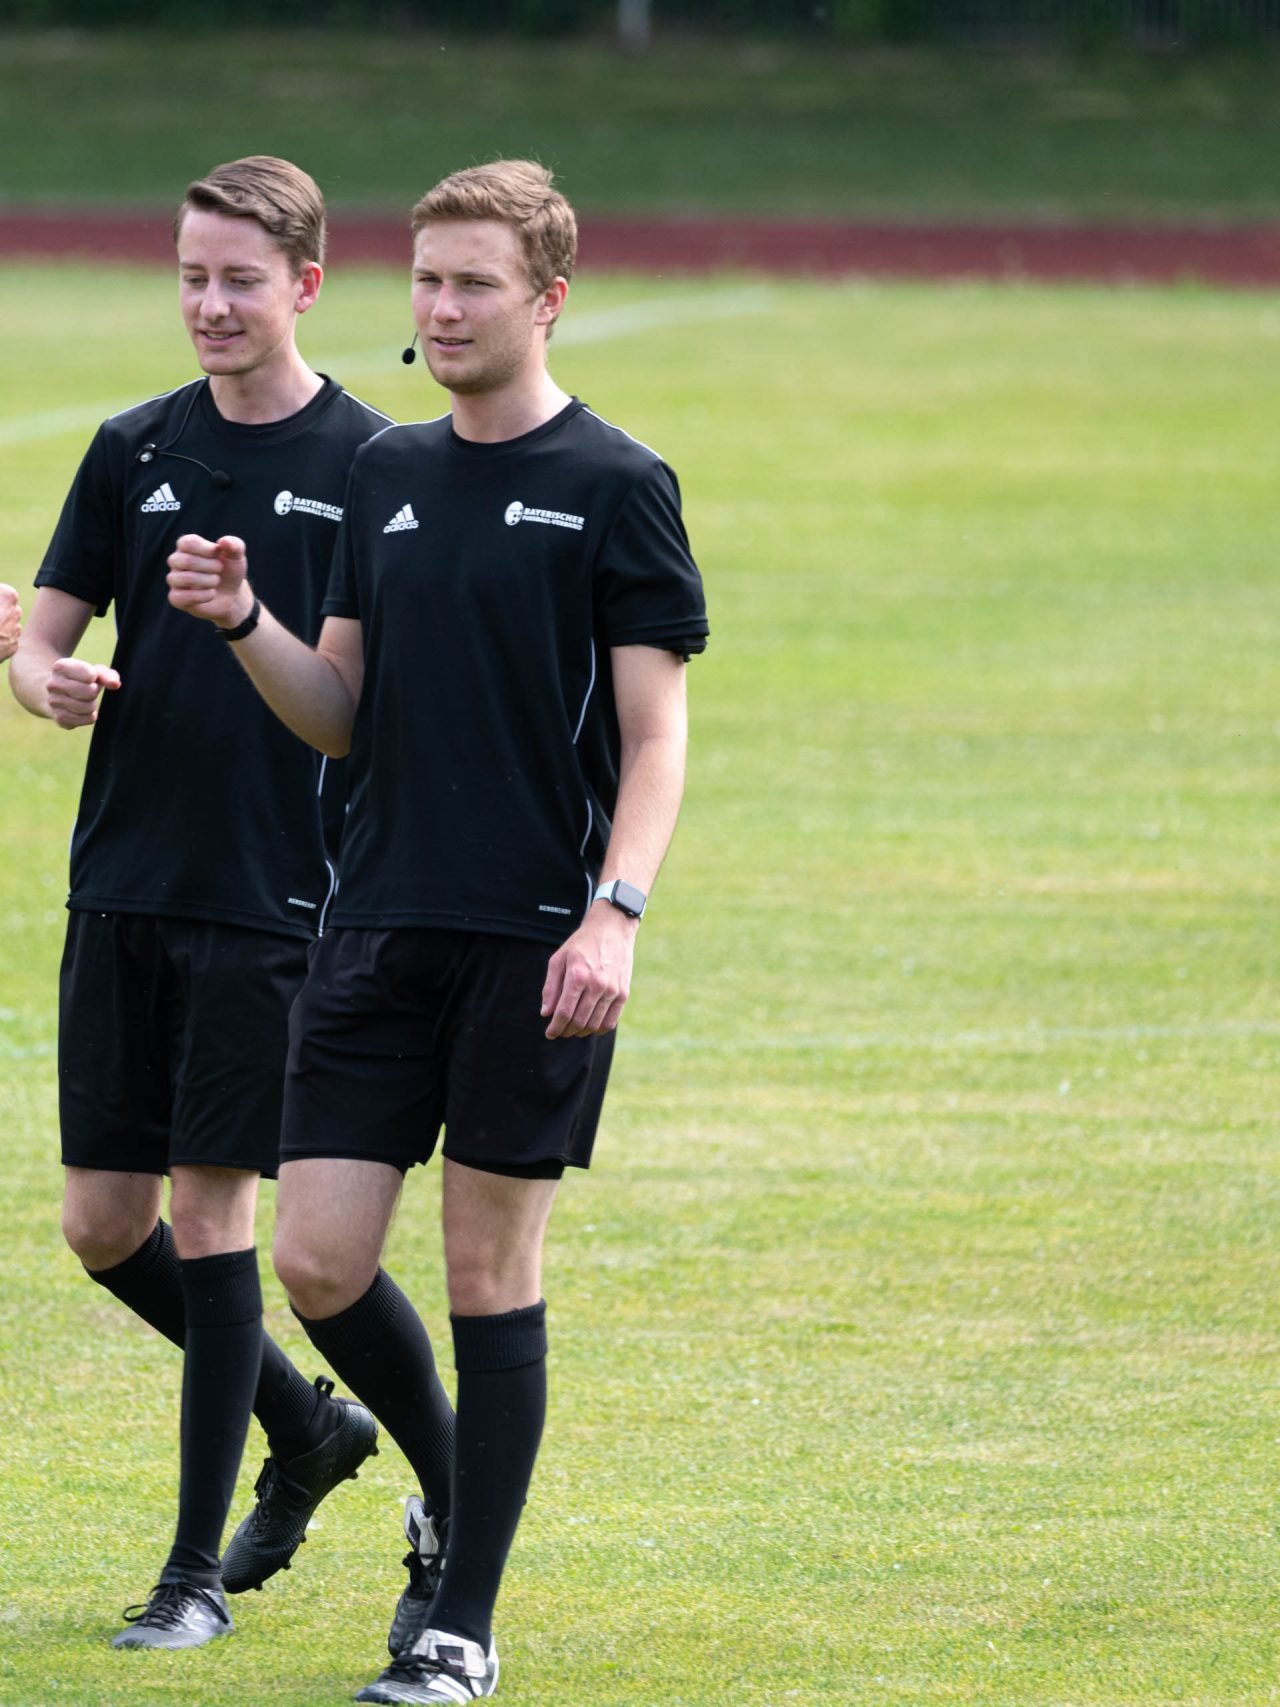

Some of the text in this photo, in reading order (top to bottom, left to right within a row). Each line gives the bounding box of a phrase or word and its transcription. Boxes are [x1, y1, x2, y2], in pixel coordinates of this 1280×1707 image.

[140, 501, 181, 513] adidas
[523, 508, 585, 525] BAYERISCHER
[382, 519, 420, 534] adidas
